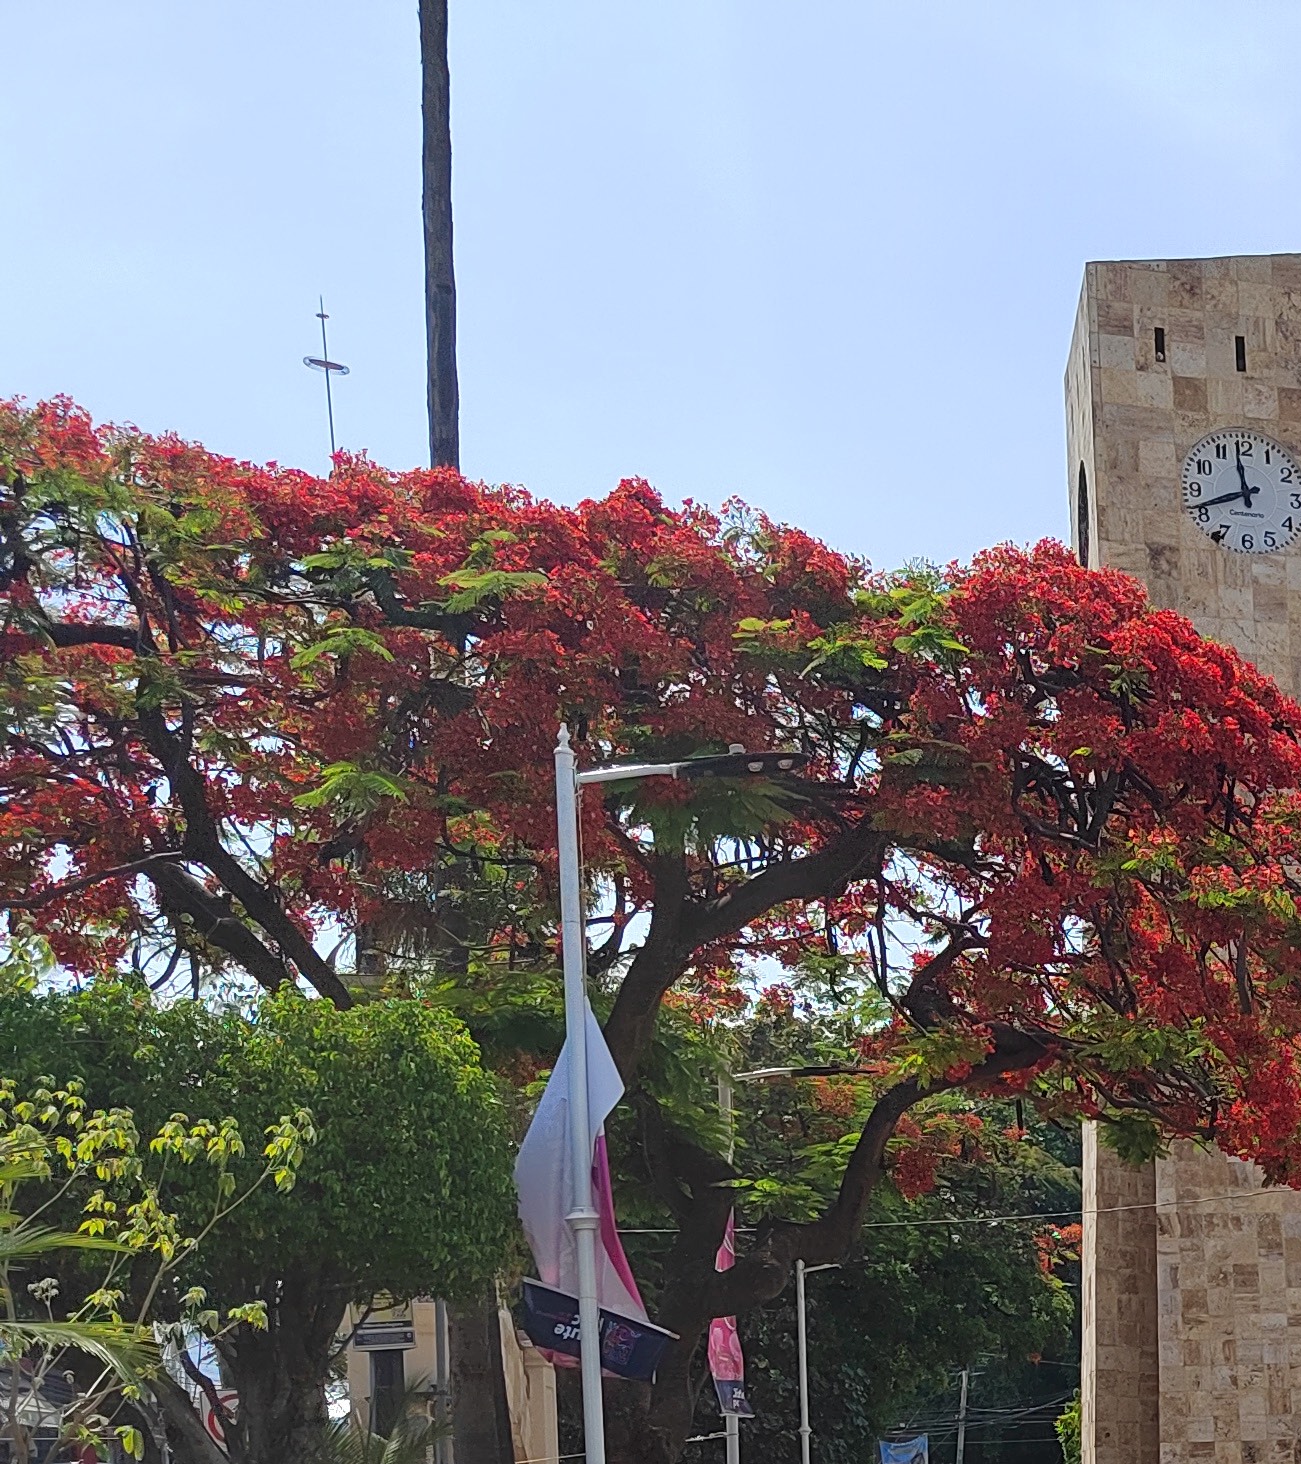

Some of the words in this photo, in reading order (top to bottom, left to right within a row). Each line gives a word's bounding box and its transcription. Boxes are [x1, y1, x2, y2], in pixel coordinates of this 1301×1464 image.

[1215, 443, 1227, 460] 11
[1234, 440, 1253, 457] 12
[1264, 448, 1271, 465] 1
[1196, 459, 1212, 476] 10
[1280, 467, 1293, 484] 2
[1189, 481, 1202, 498] 9
[1289, 493, 1301, 509] 3
[1198, 506, 1210, 523] 8
[1219, 524, 1232, 540] 7
[1281, 516, 1293, 532] 4
[1241, 533, 1254, 549] 6
[1263, 531, 1276, 547] 5
